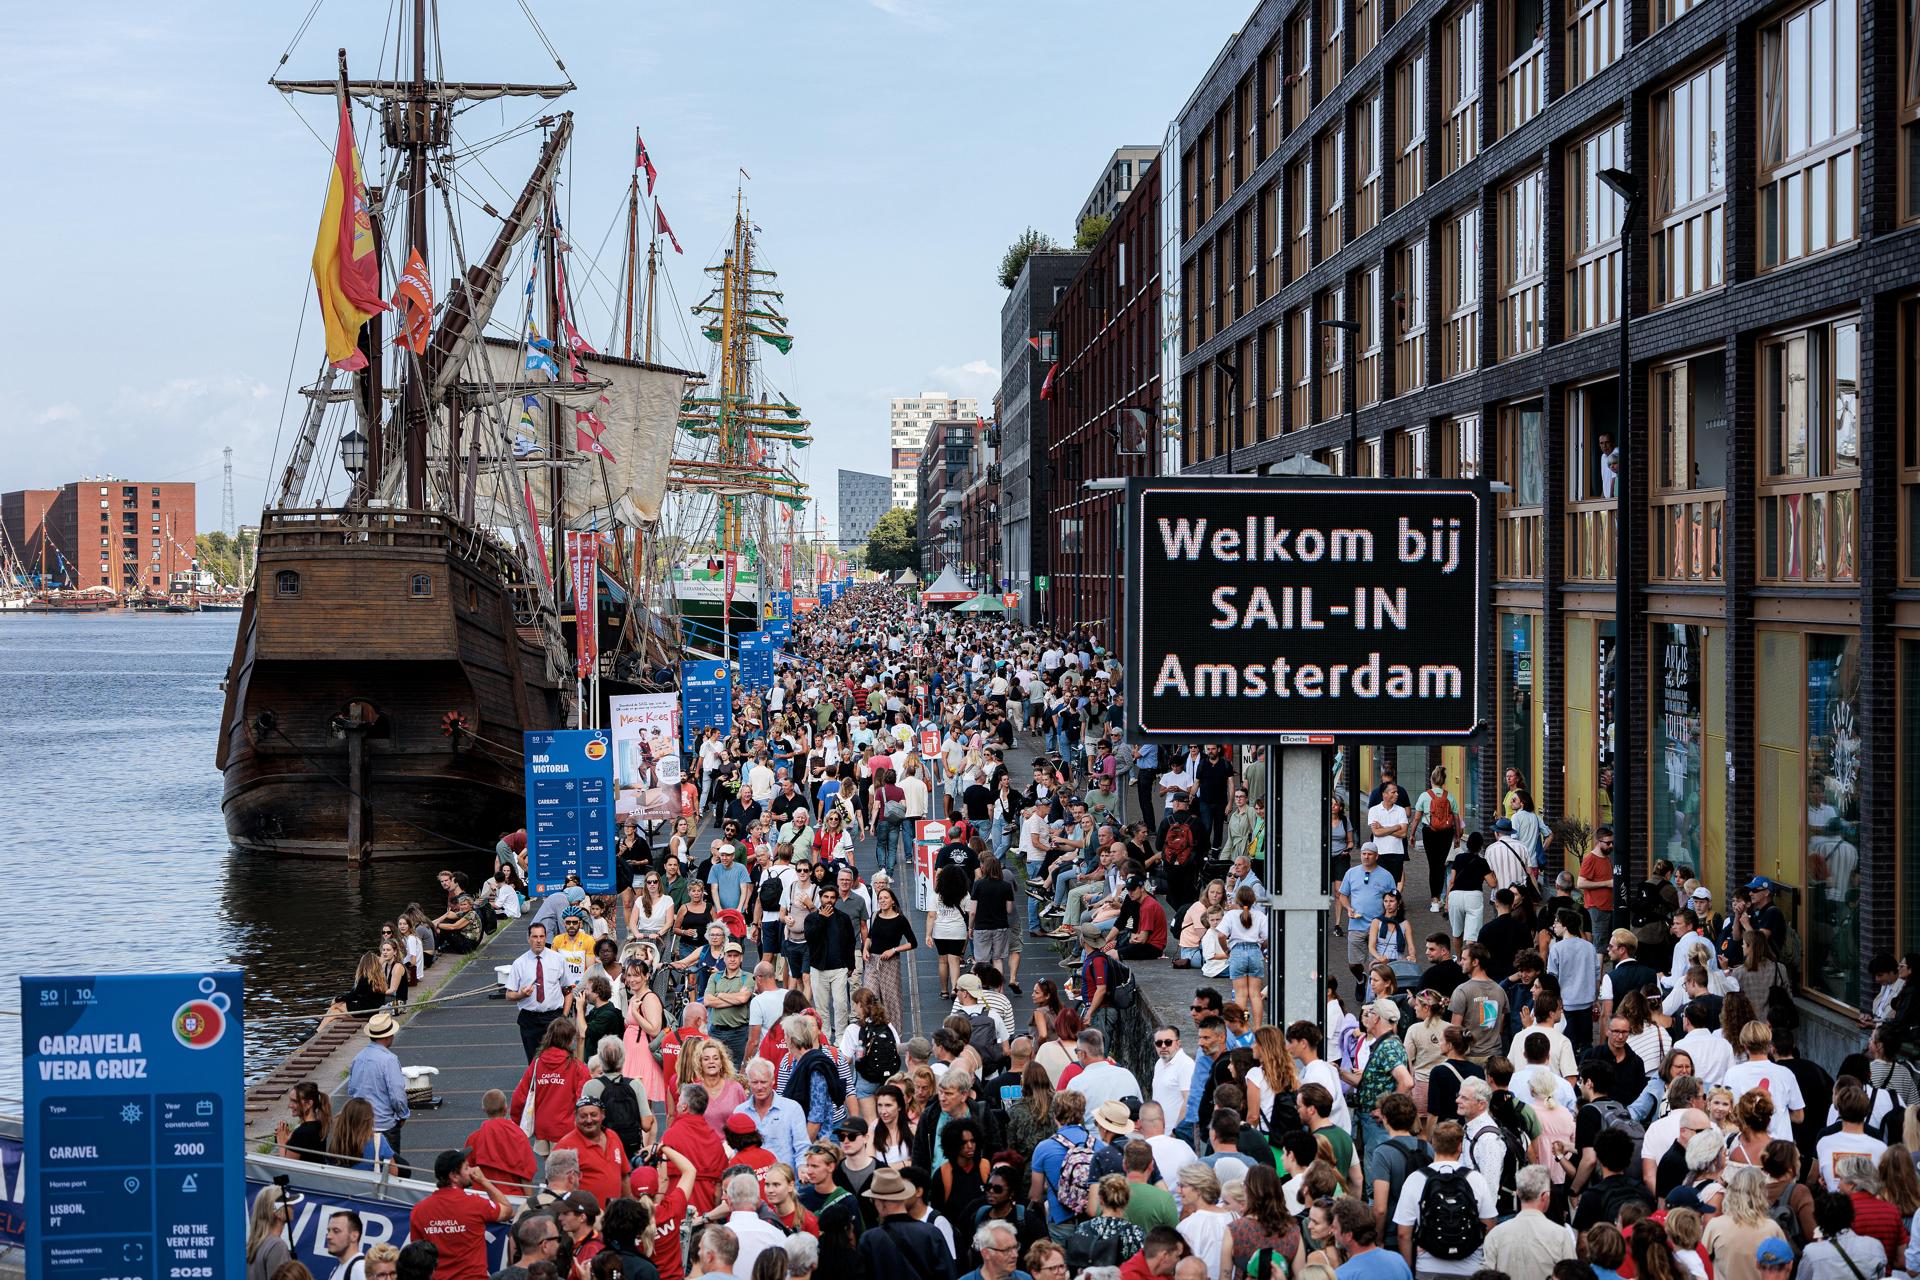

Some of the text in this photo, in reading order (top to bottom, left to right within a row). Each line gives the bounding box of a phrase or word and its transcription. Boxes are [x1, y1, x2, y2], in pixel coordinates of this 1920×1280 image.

[1157, 516, 1461, 574] Welkom bij
[1210, 586, 1408, 630] SAIL-IN
[1664, 644, 1688, 670] ART IS
[1153, 652, 1463, 698] Amsterdam
[1664, 658, 1689, 689] the lie
[1664, 712, 1689, 743] TRUTH
[532, 755, 549, 763] NAO
[532, 765, 569, 773] VICTORIA
[40, 990, 58, 1001] 50
[76, 988, 95, 999] 10.
[39, 1033, 142, 1055] CARAVELA
[39, 1058, 147, 1080] VERA CRUZ
[49, 1146, 98, 1159] CARAVEL
[174, 1143, 204, 1155] 2000
[71, 1180, 87, 1188] port
[49, 1204, 85, 1215] LISBON,
[50, 1217, 62, 1227] PT
[172, 1224, 209, 1235] FOR THE
[424, 1224, 466, 1234] VERA CRUZ
[166, 1236, 214, 1247] VERY FIRST
[51, 1247, 102, 1256] Measurements
[174, 1249, 208, 1260] TIME IN
[59, 1257, 83, 1265] meters
[170, 1268, 213, 1278] 2025
